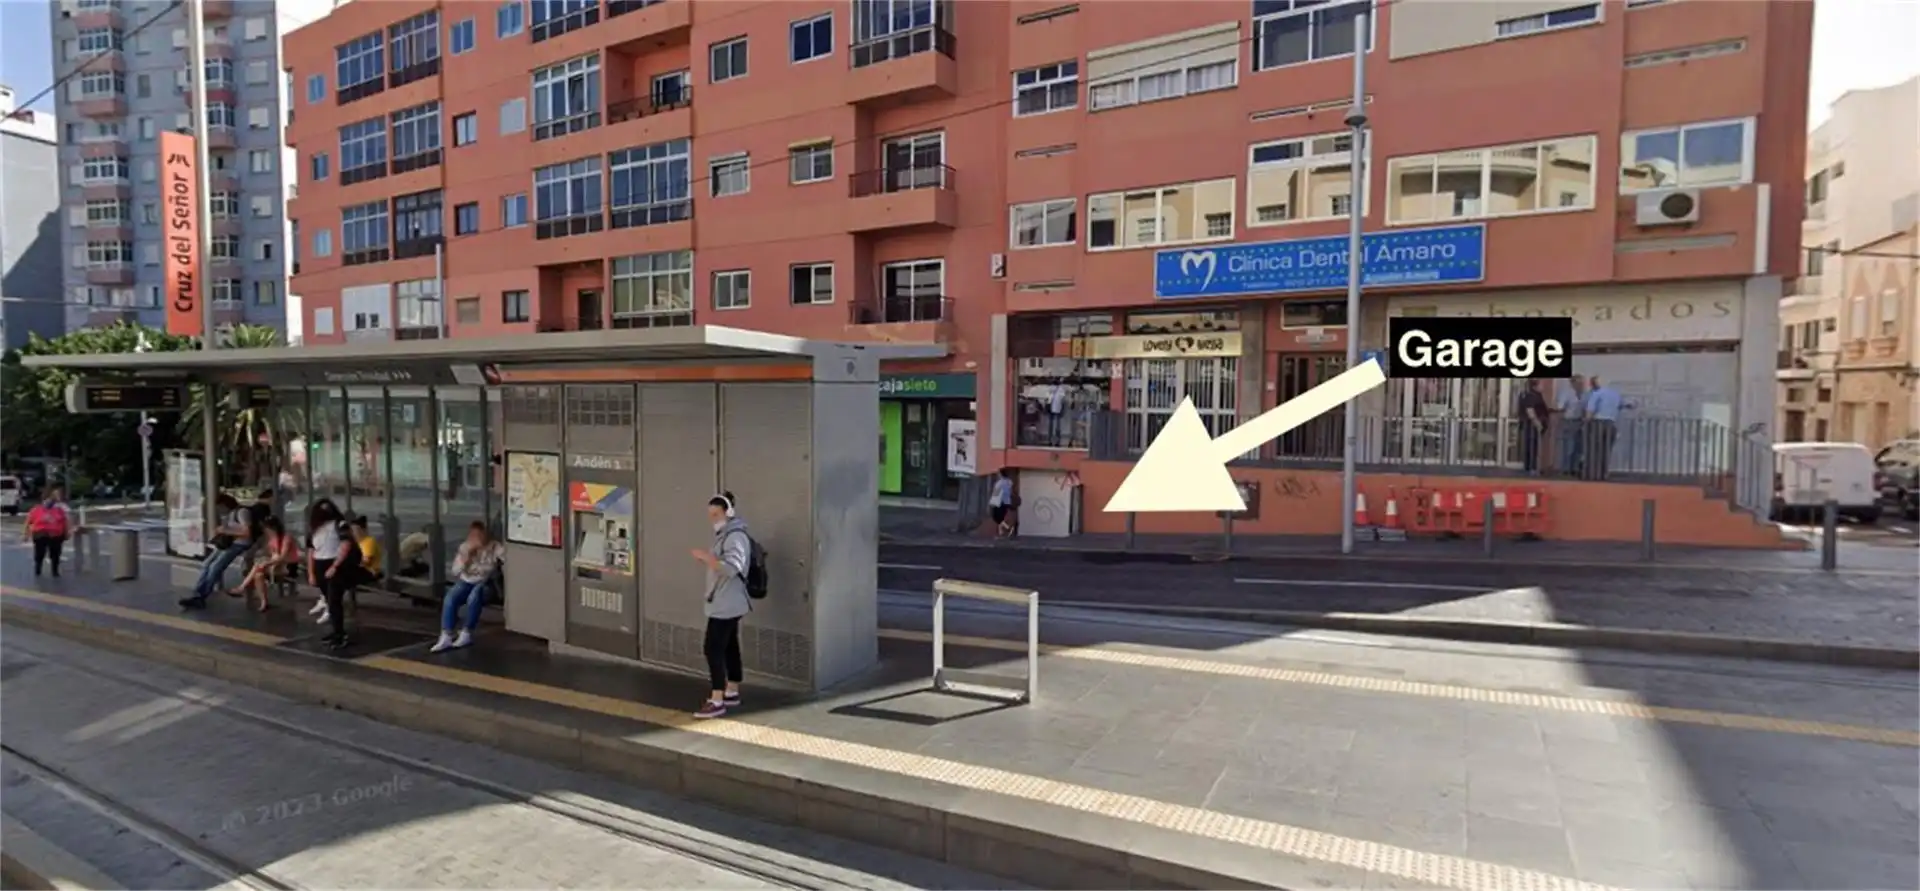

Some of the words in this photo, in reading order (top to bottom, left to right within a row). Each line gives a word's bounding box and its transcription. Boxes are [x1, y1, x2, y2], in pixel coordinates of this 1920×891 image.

[168, 172, 191, 231] Señor
[170, 236, 191, 264] del
[1299, 245, 1368, 268] Dentl
[175, 269, 193, 313] Cruz
